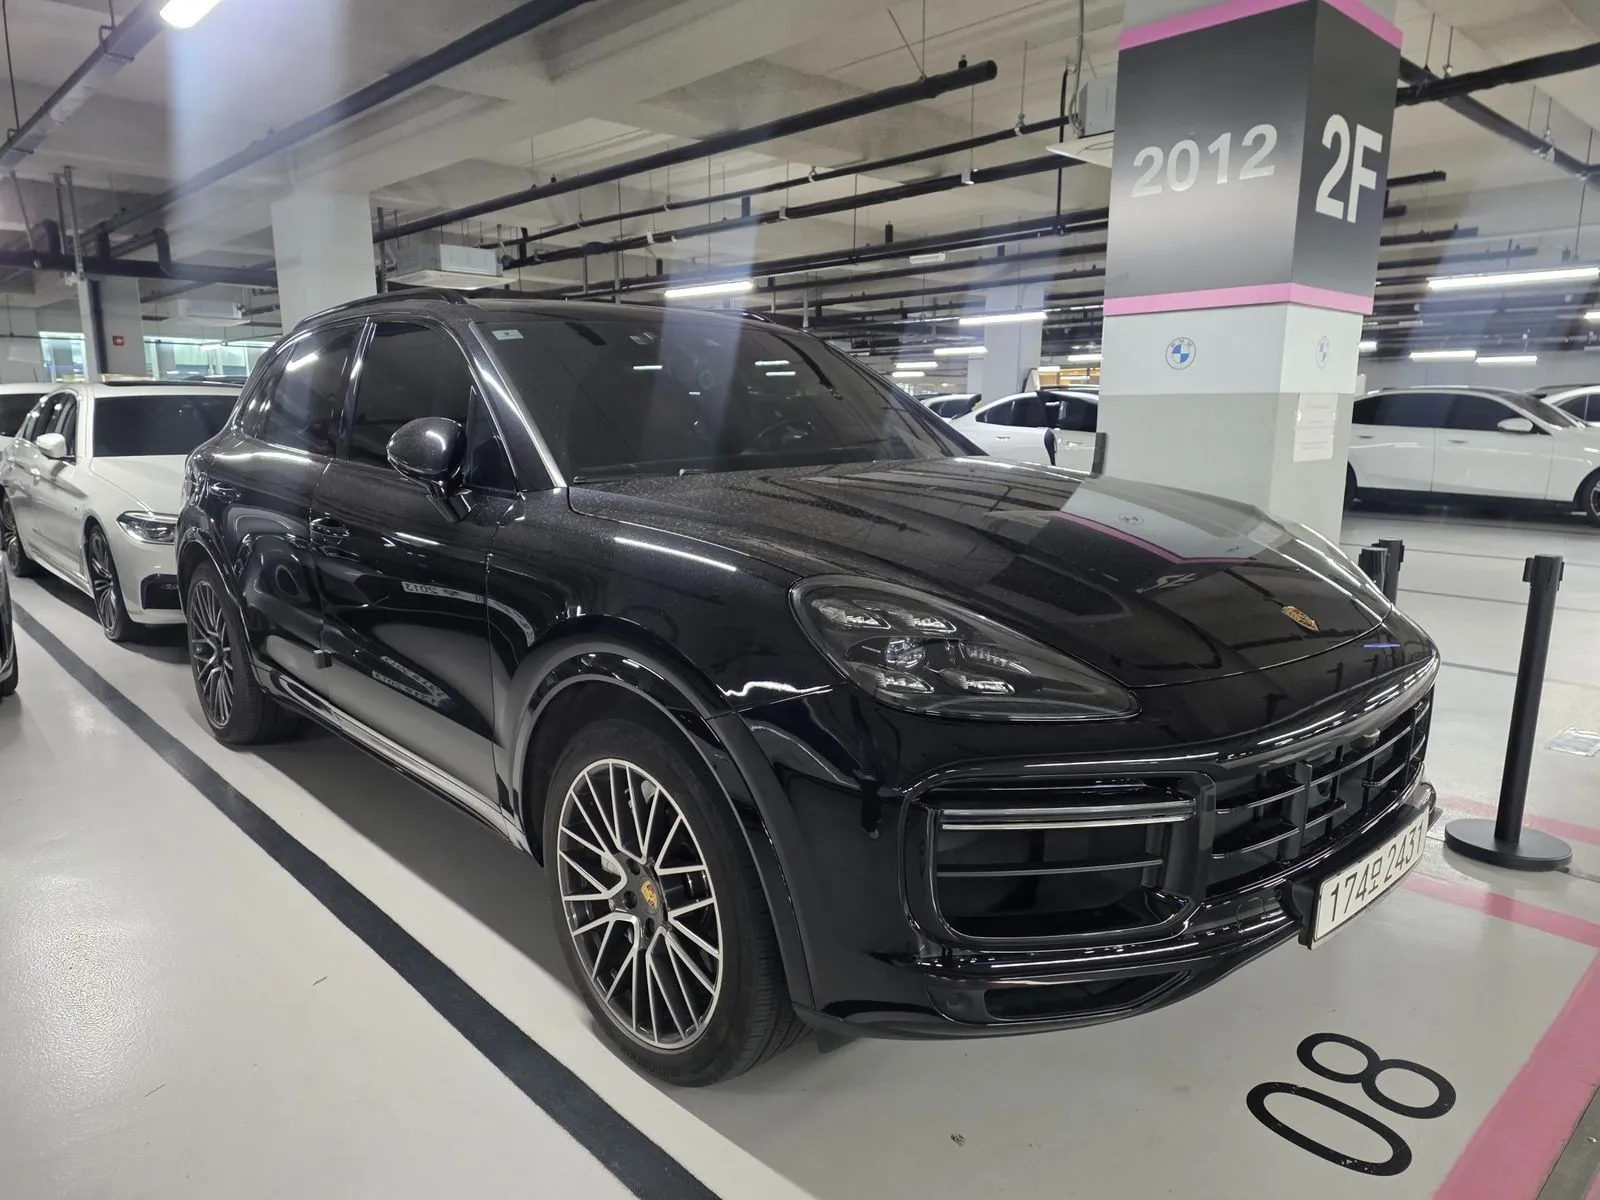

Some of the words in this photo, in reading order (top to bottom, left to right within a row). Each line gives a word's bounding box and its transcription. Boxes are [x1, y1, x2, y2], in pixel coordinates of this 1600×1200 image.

[1131, 123, 1278, 198] 2012
[1315, 114, 1383, 223] 2F
[1330, 856, 1383, 922] 174모
[1384, 819, 1424, 883] 2431
[1246, 1032, 1456, 1176] 08
